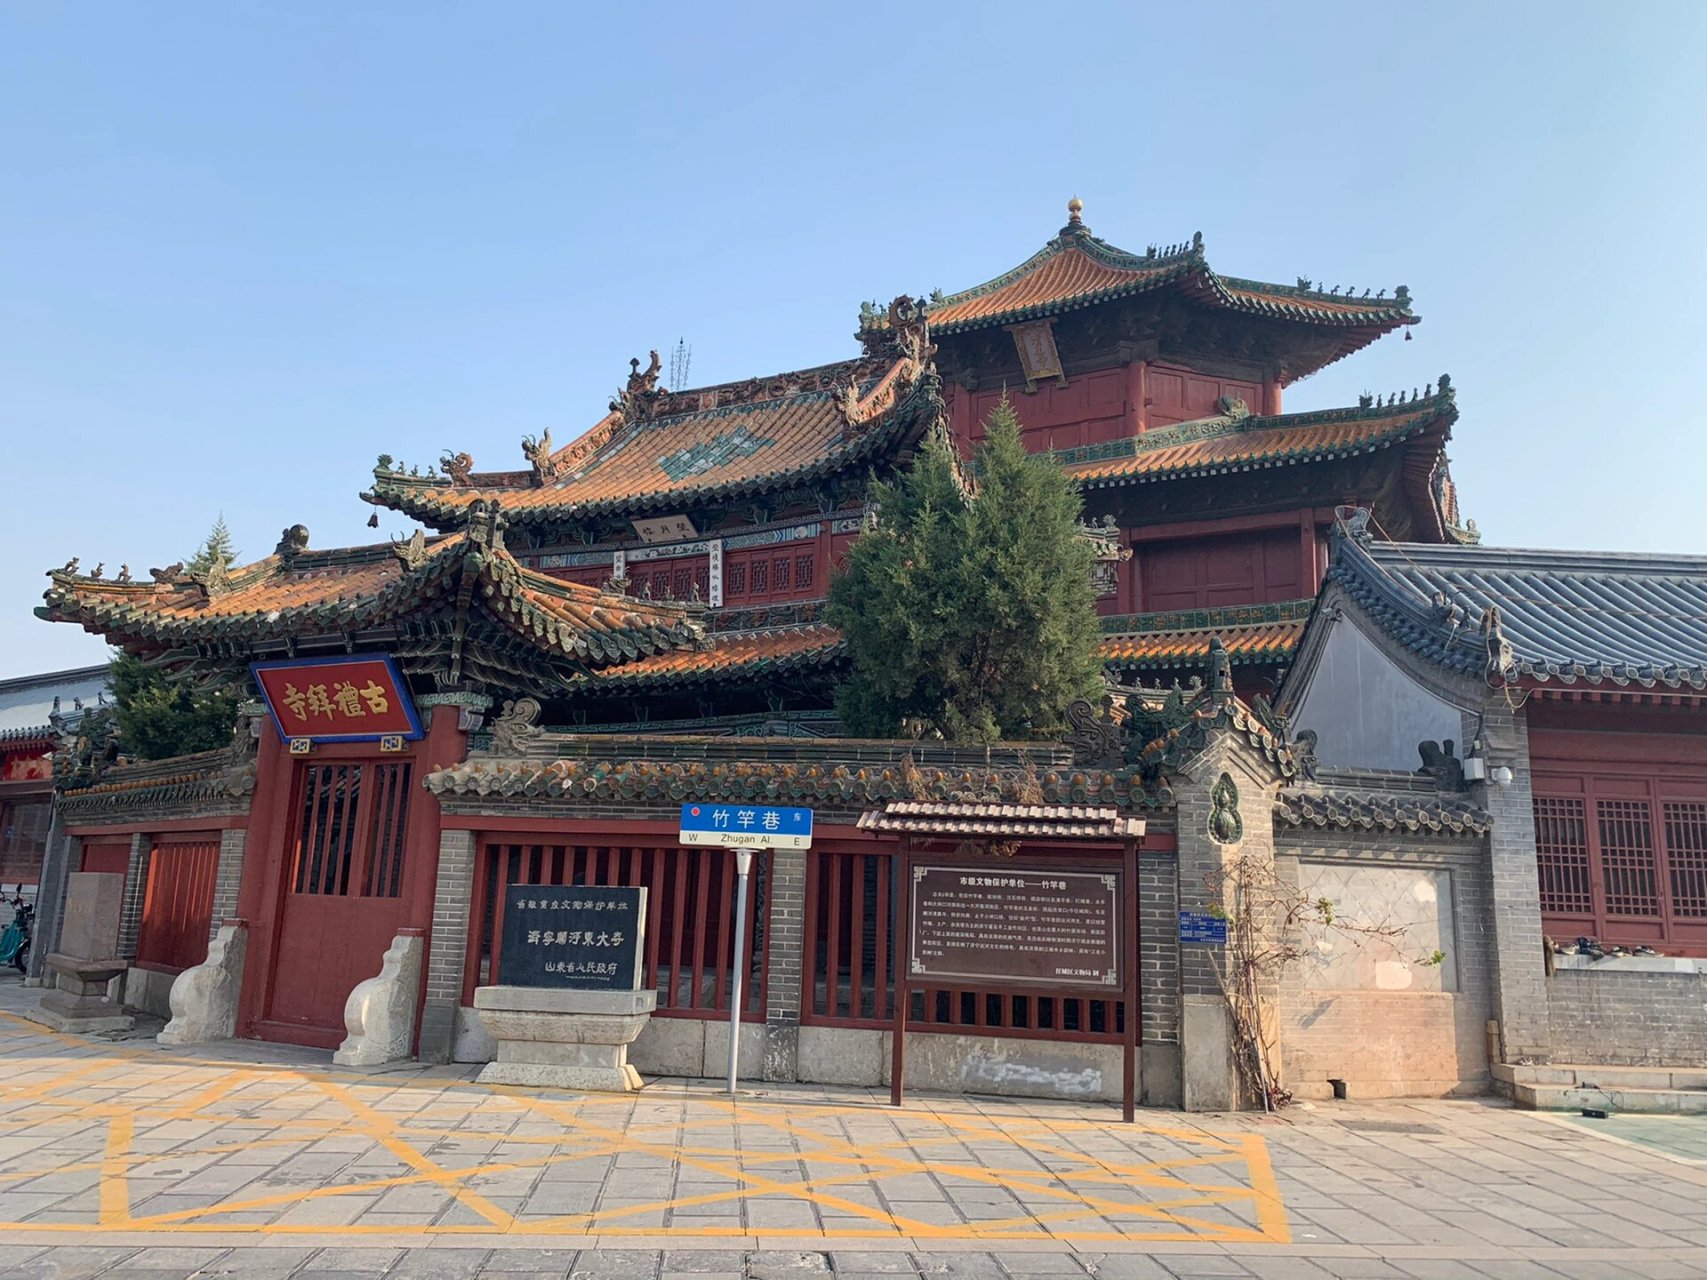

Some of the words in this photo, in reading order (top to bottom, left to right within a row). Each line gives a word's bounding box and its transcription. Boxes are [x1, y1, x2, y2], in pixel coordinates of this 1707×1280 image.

[712, 809, 781, 830] 竹竿巷
[688, 834, 699, 842] W
[720, 834, 756, 845] Zhugan
[793, 837, 801, 846] E
